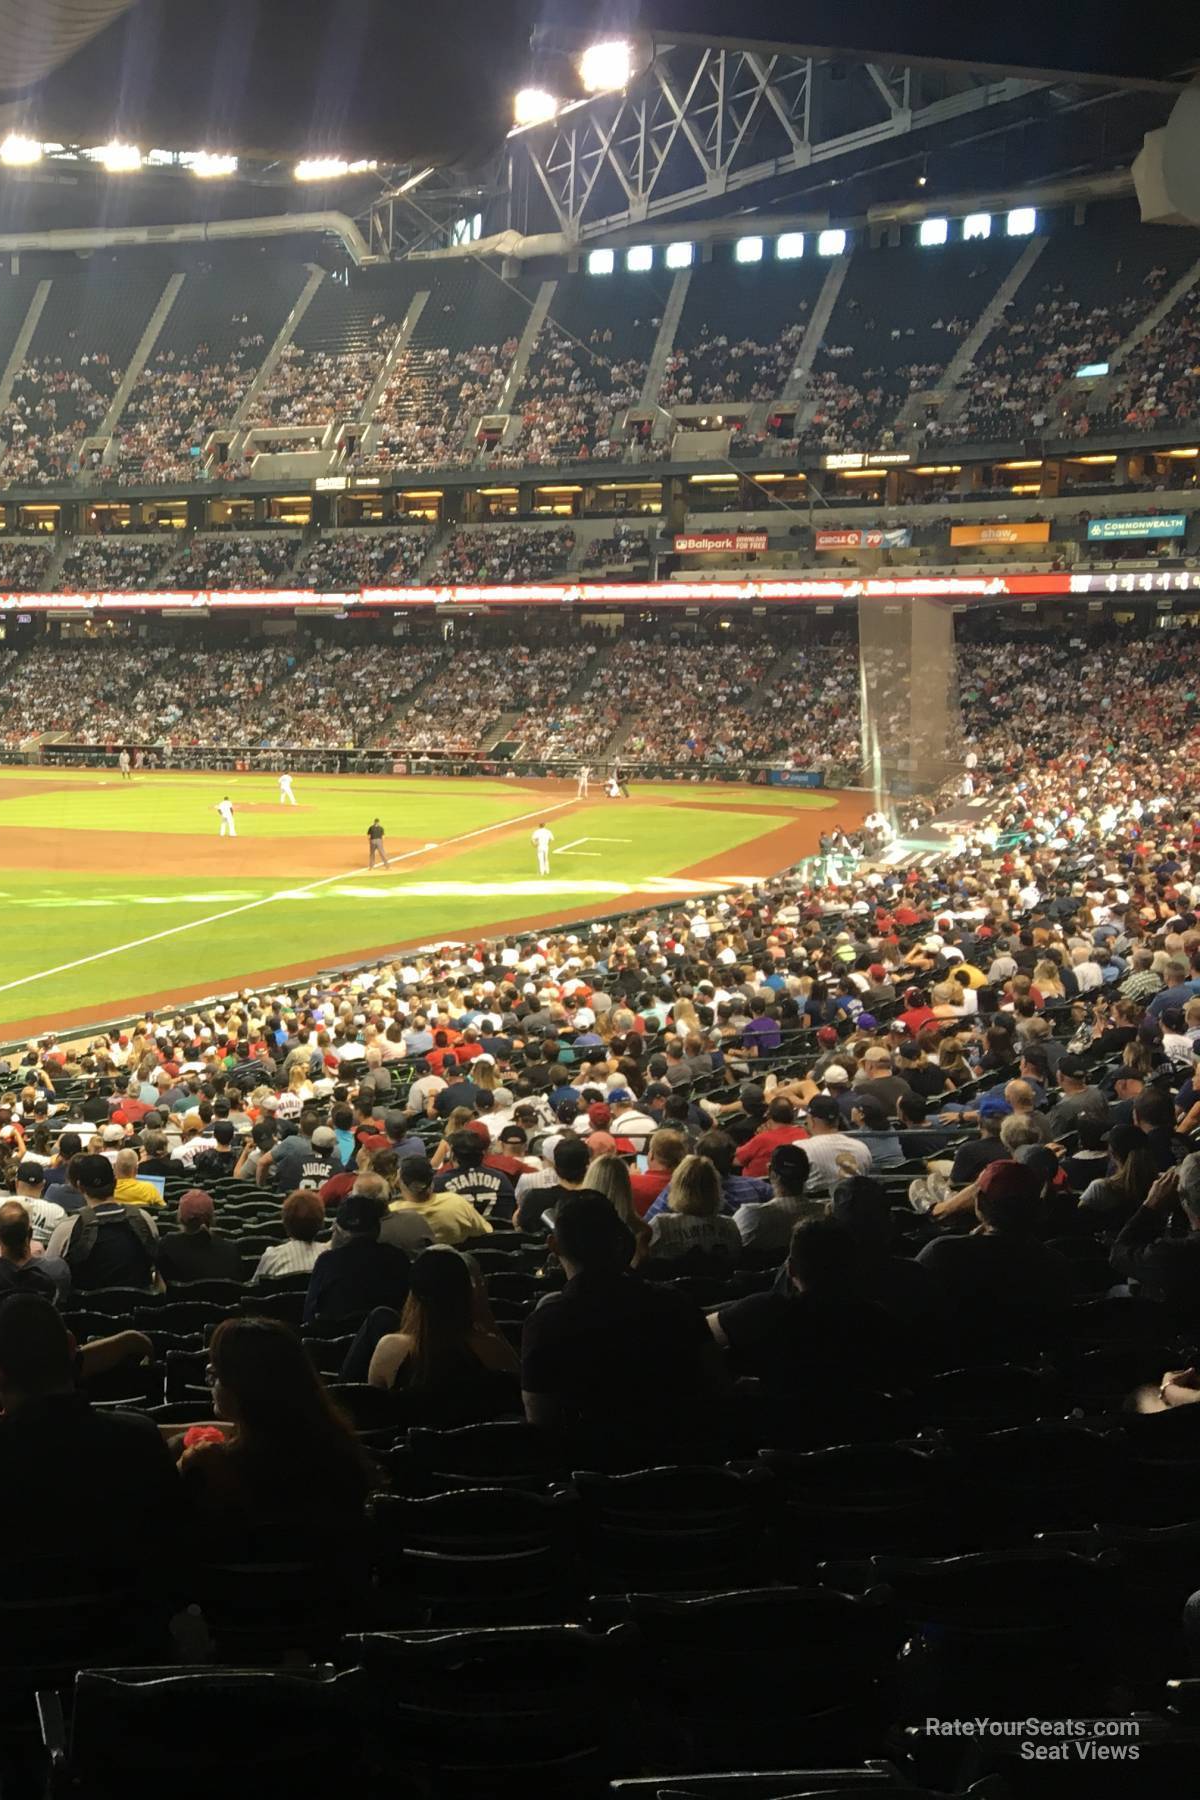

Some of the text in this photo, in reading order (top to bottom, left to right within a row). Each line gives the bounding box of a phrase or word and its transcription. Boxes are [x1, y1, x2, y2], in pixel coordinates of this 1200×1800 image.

[1103, 520, 1183, 531] COMMONWEALTH
[687, 538, 733, 551] Ballpark
[819, 536, 846, 544] CIRCLE
[302, 1162, 333, 1177] JUDGE
[445, 1172, 502, 1193] STANTON
